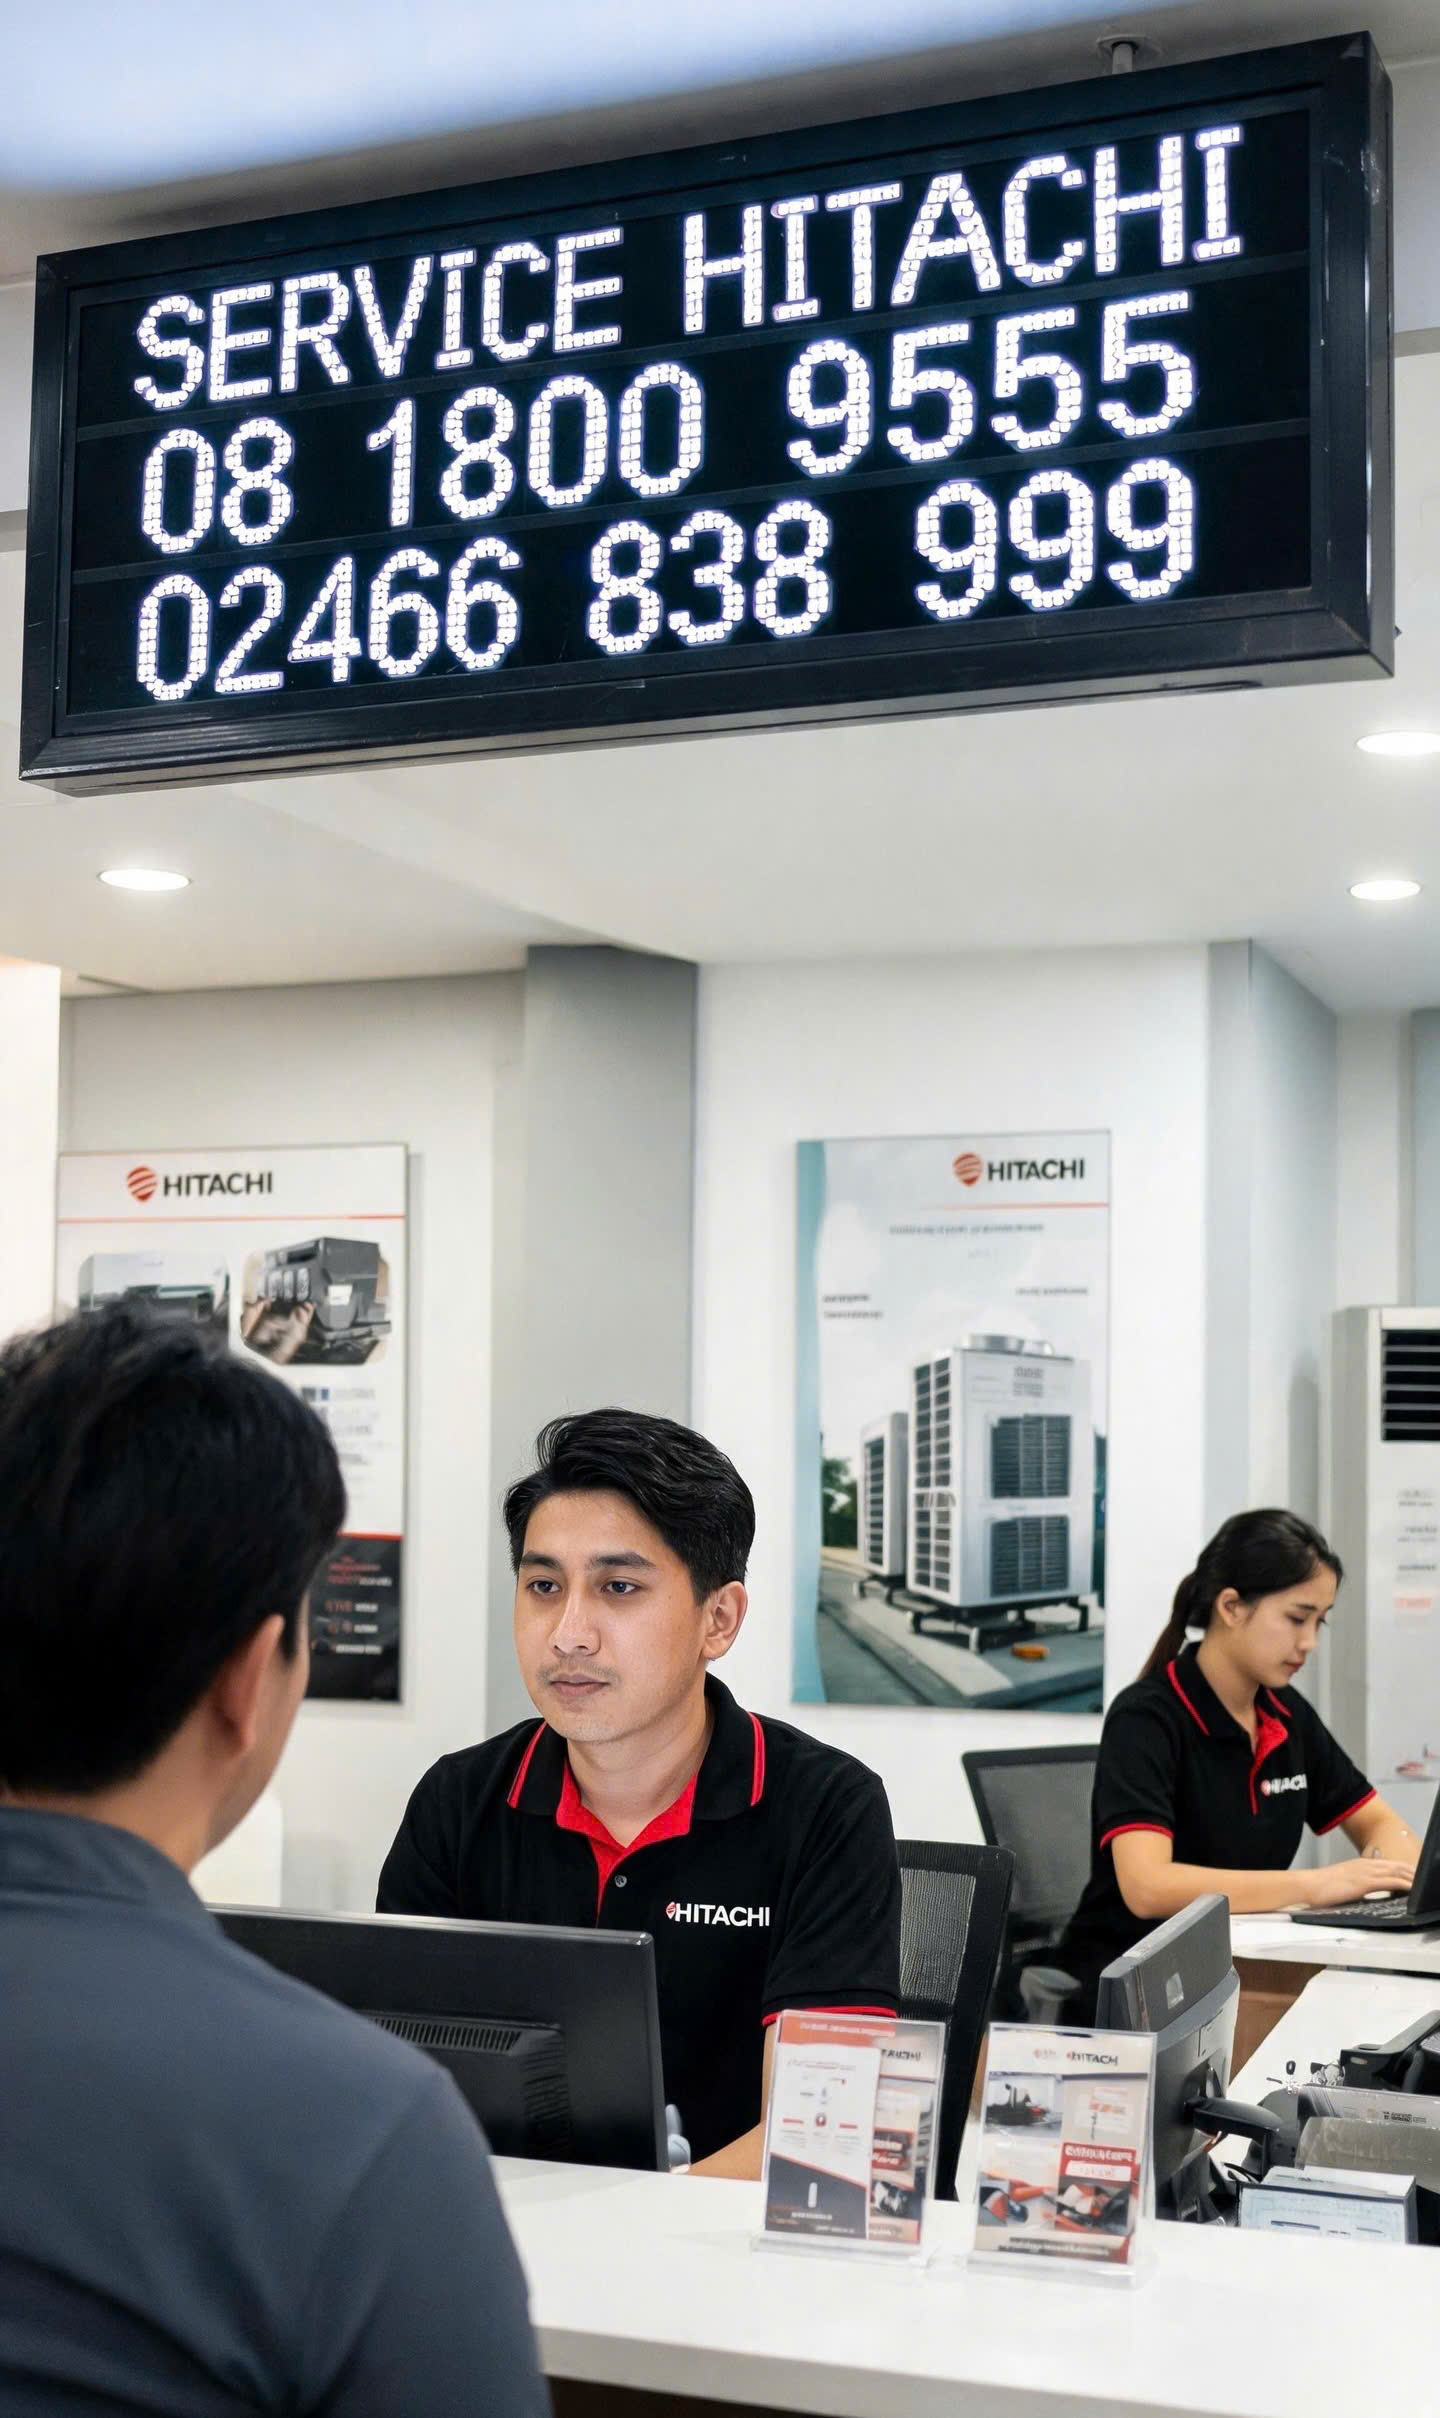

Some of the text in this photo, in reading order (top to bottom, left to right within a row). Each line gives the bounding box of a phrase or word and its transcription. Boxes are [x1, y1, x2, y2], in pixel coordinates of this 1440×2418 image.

[133, 126, 1241, 410] SERVICE HITACHI
[141, 290, 1194, 554] 08 1800 9555
[136, 457, 1194, 701] 02466 838 999
[163, 1171, 273, 1197] HITACHI
[987, 1158, 1085, 1181] HITACHI
[674, 1903, 770, 1927] HITACHI
